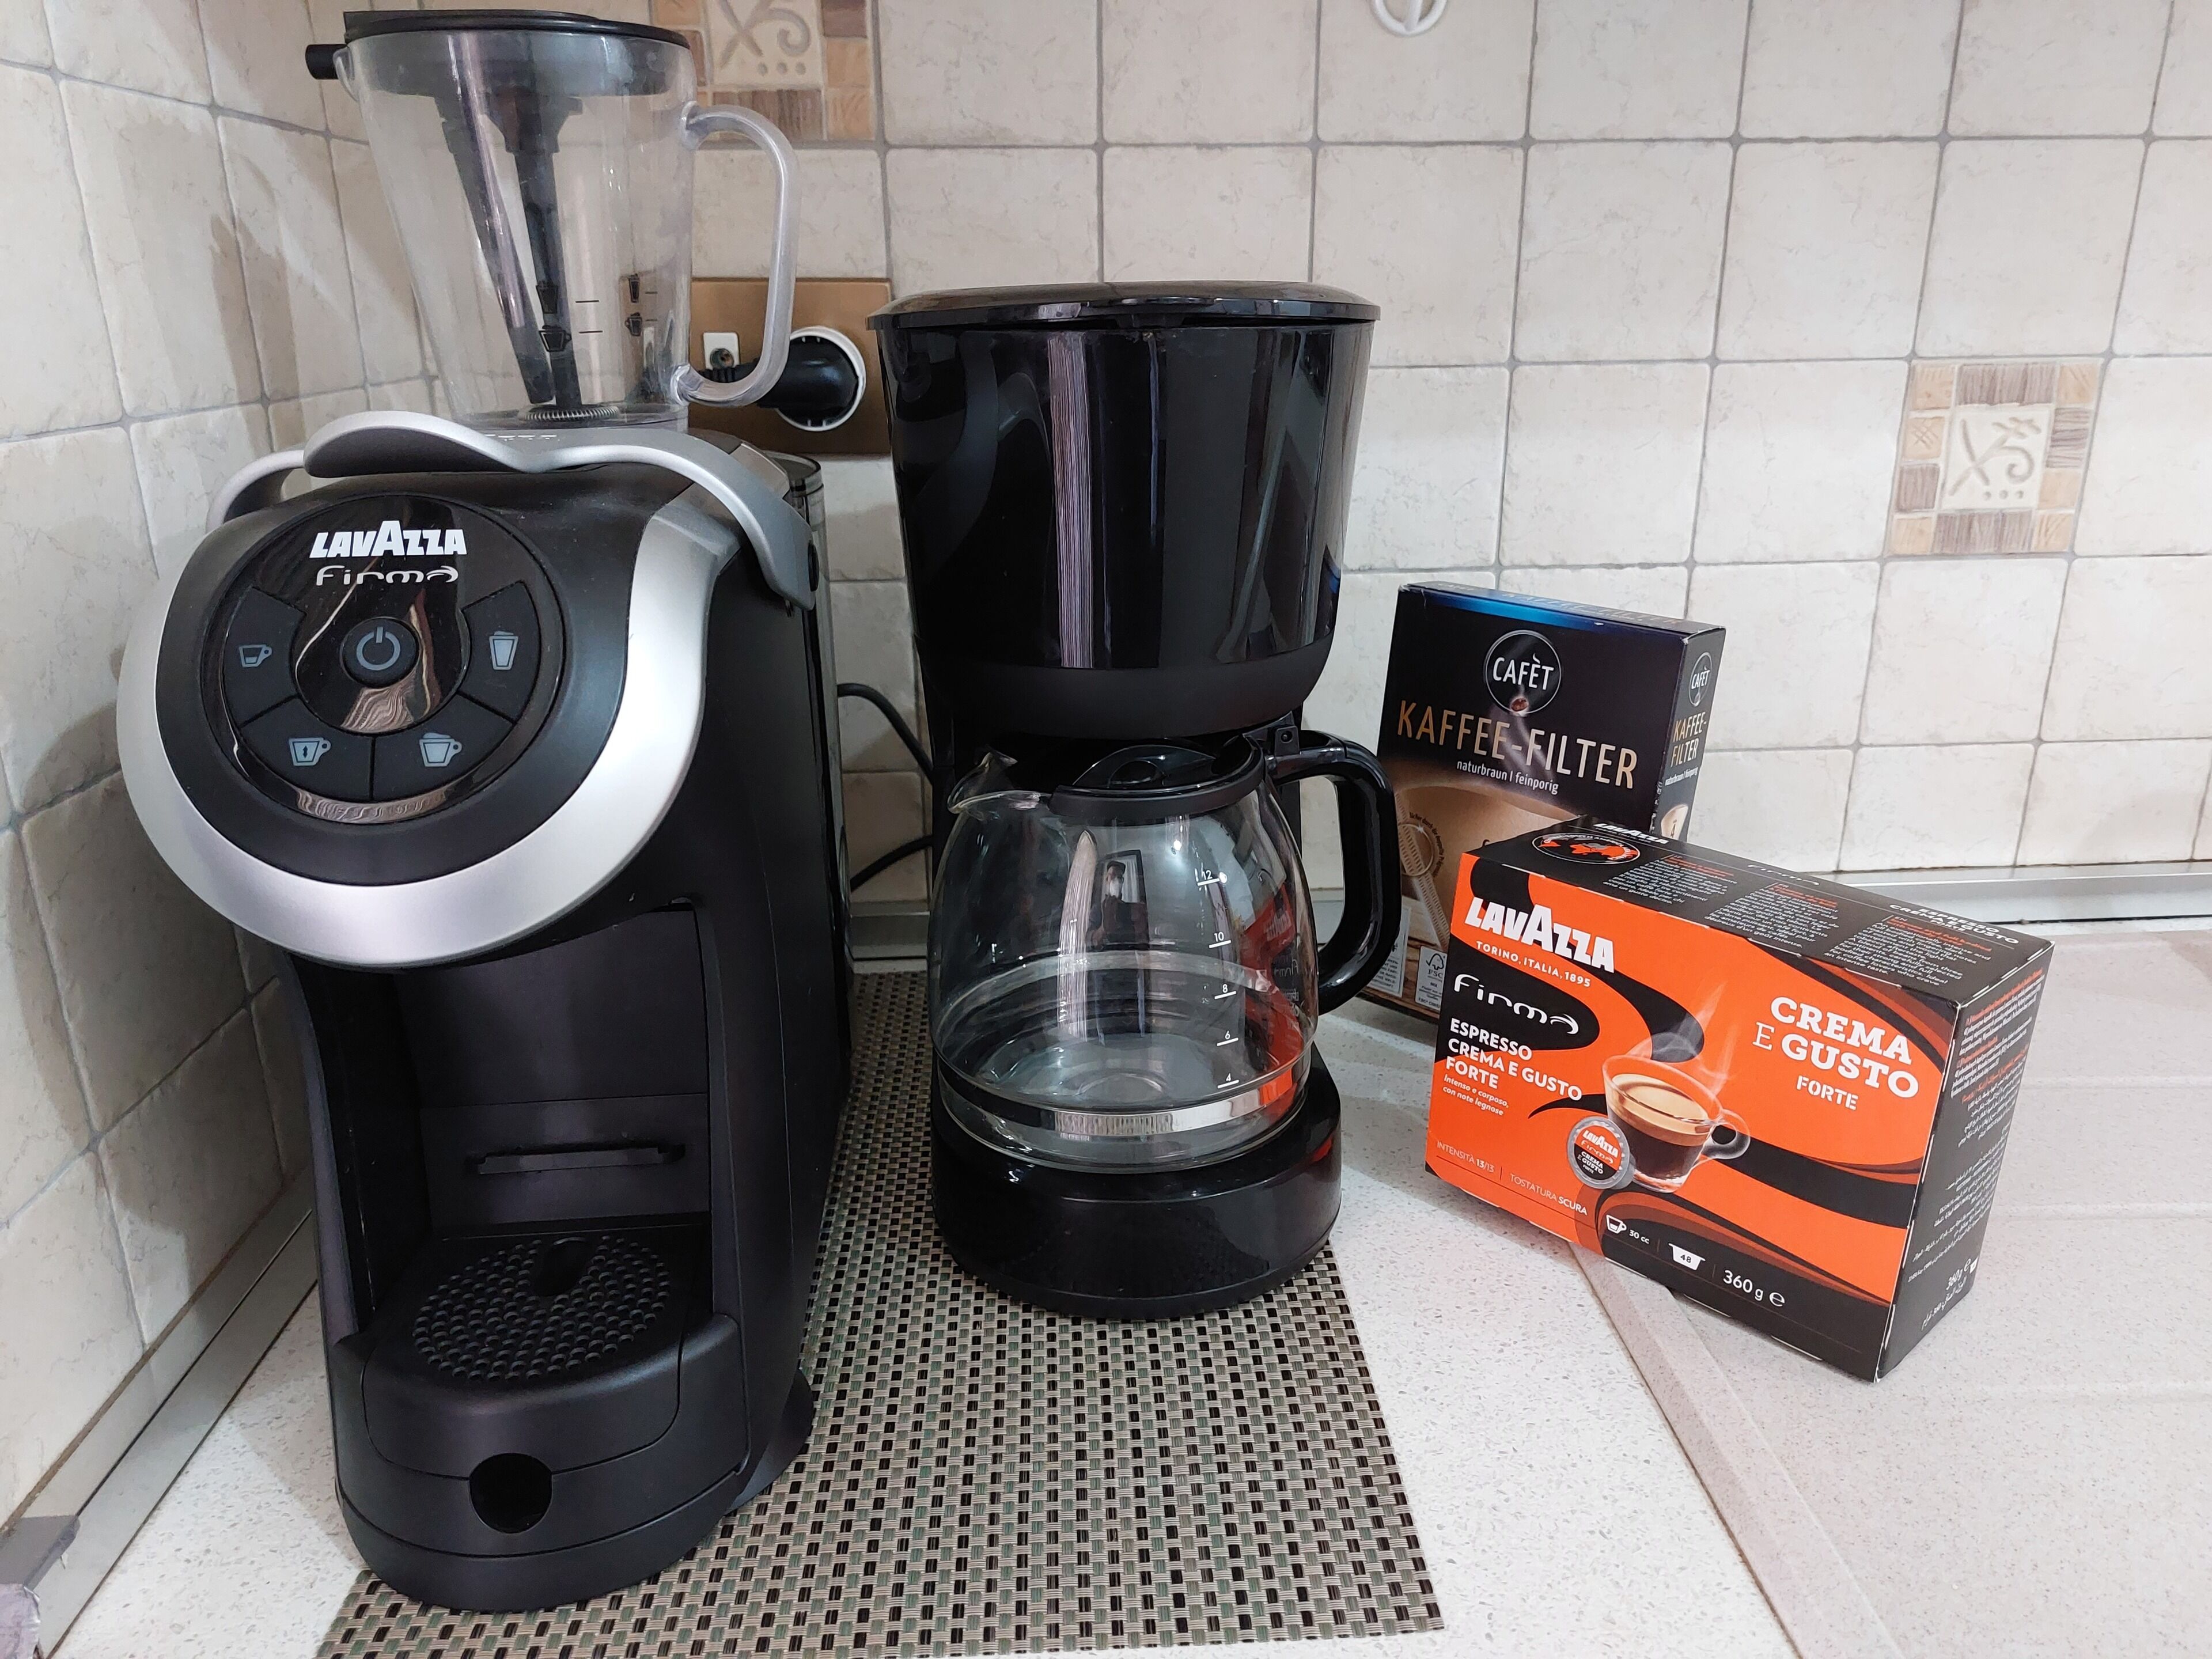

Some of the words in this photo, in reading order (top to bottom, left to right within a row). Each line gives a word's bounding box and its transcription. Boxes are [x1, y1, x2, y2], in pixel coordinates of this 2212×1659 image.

[309, 520, 467, 558] LAVAZZA
[1493, 653, 1554, 690] CAFÈT
[1673, 711, 1707, 743] KAFFEE-
[1397, 700, 1638, 789] KAFFEE-FILTER
[1671, 738, 1699, 768] FILTER
[1457, 760, 1508, 781] naturbraun
[1516, 772, 1559, 795] feinporig
[1593, 823, 1669, 844] LAVAZZA
[1214, 931, 1225, 942] 10
[1464, 896, 1615, 974] LAVAZZA
[1889, 904, 1944, 922] CREMA
[1961, 924, 2020, 944] GUSTO
[1919, 908, 2000, 933] ESPRESSO
[1930, 919, 1966, 931] FORTE
[1476, 940, 1522, 965] TORINO,
[1523, 957, 1563, 980] ITALIA,
[1564, 971, 1591, 987] 1895
[1222, 984, 1229, 993] 8
[1225, 1031, 1231, 1040] 6
[1450, 1017, 1533, 1060] ESPRESSO
[1770, 996, 1913, 1065] CREMA
[1445, 1055, 1499, 1089] FORTE
[1448, 1038, 1505, 1072] CREMA
[1508, 1060, 1519, 1077] E
[1521, 1067, 1582, 1101] GUSTO
[1752, 1021, 1775, 1051] E
[1781, 1033, 1919, 1099] GUSTO
[1225, 1073, 1232, 1082] 4
[1444, 1073, 1471, 1092] Intenso
[1478, 1090, 1509, 1108] corposo,
[1796, 1075, 1859, 1111] FORTE
[1442, 1086, 1456, 1096] con
[1457, 1092, 1474, 1104] note
[1475, 1097, 1504, 1116] legnose
[1437, 1140, 1475, 1164] INTENSITÀ
[1581, 1151, 1604, 1169] CREMA
[1582, 1130, 1619, 1158] LAVAZZA
[1582, 1157, 1604, 1175] GUSTO
[1509, 1172, 1558, 1202] TOSTATURA
[1558, 1195, 1588, 1216] SCURA
[1629, 1229, 1640, 1240] 30
[1640, 1236, 1650, 1245] cc
[1680, 1253, 1692, 1264] 48
[1722, 1269, 1753, 1294] 360
[1754, 1288, 1764, 1302] g
